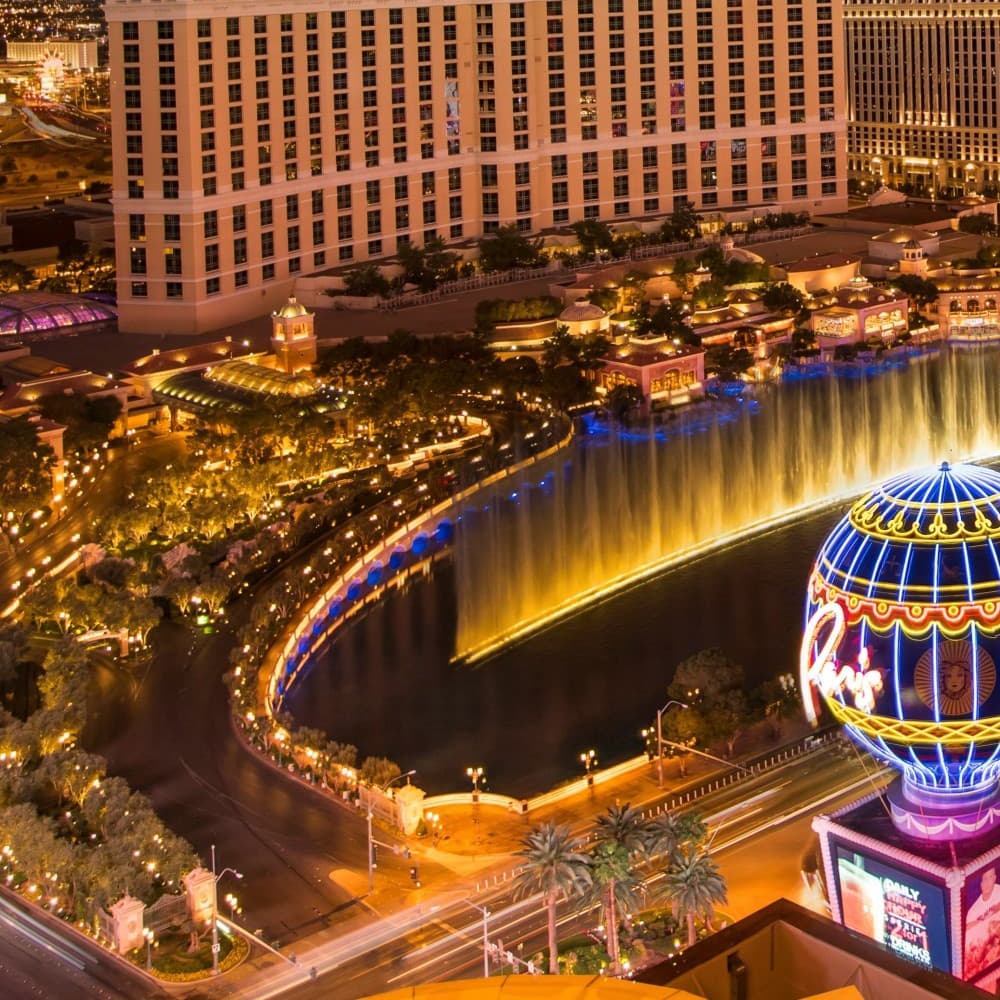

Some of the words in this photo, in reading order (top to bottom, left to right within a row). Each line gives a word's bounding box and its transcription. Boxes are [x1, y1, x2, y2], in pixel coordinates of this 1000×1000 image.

[883, 878, 920, 901] DAILY
[885, 902, 923, 924] HOUR
[886, 892, 927, 914] HAPPY
[888, 920, 904, 939] 2
[919, 931, 928, 950] 1
[890, 936, 931, 965] DRINKS
